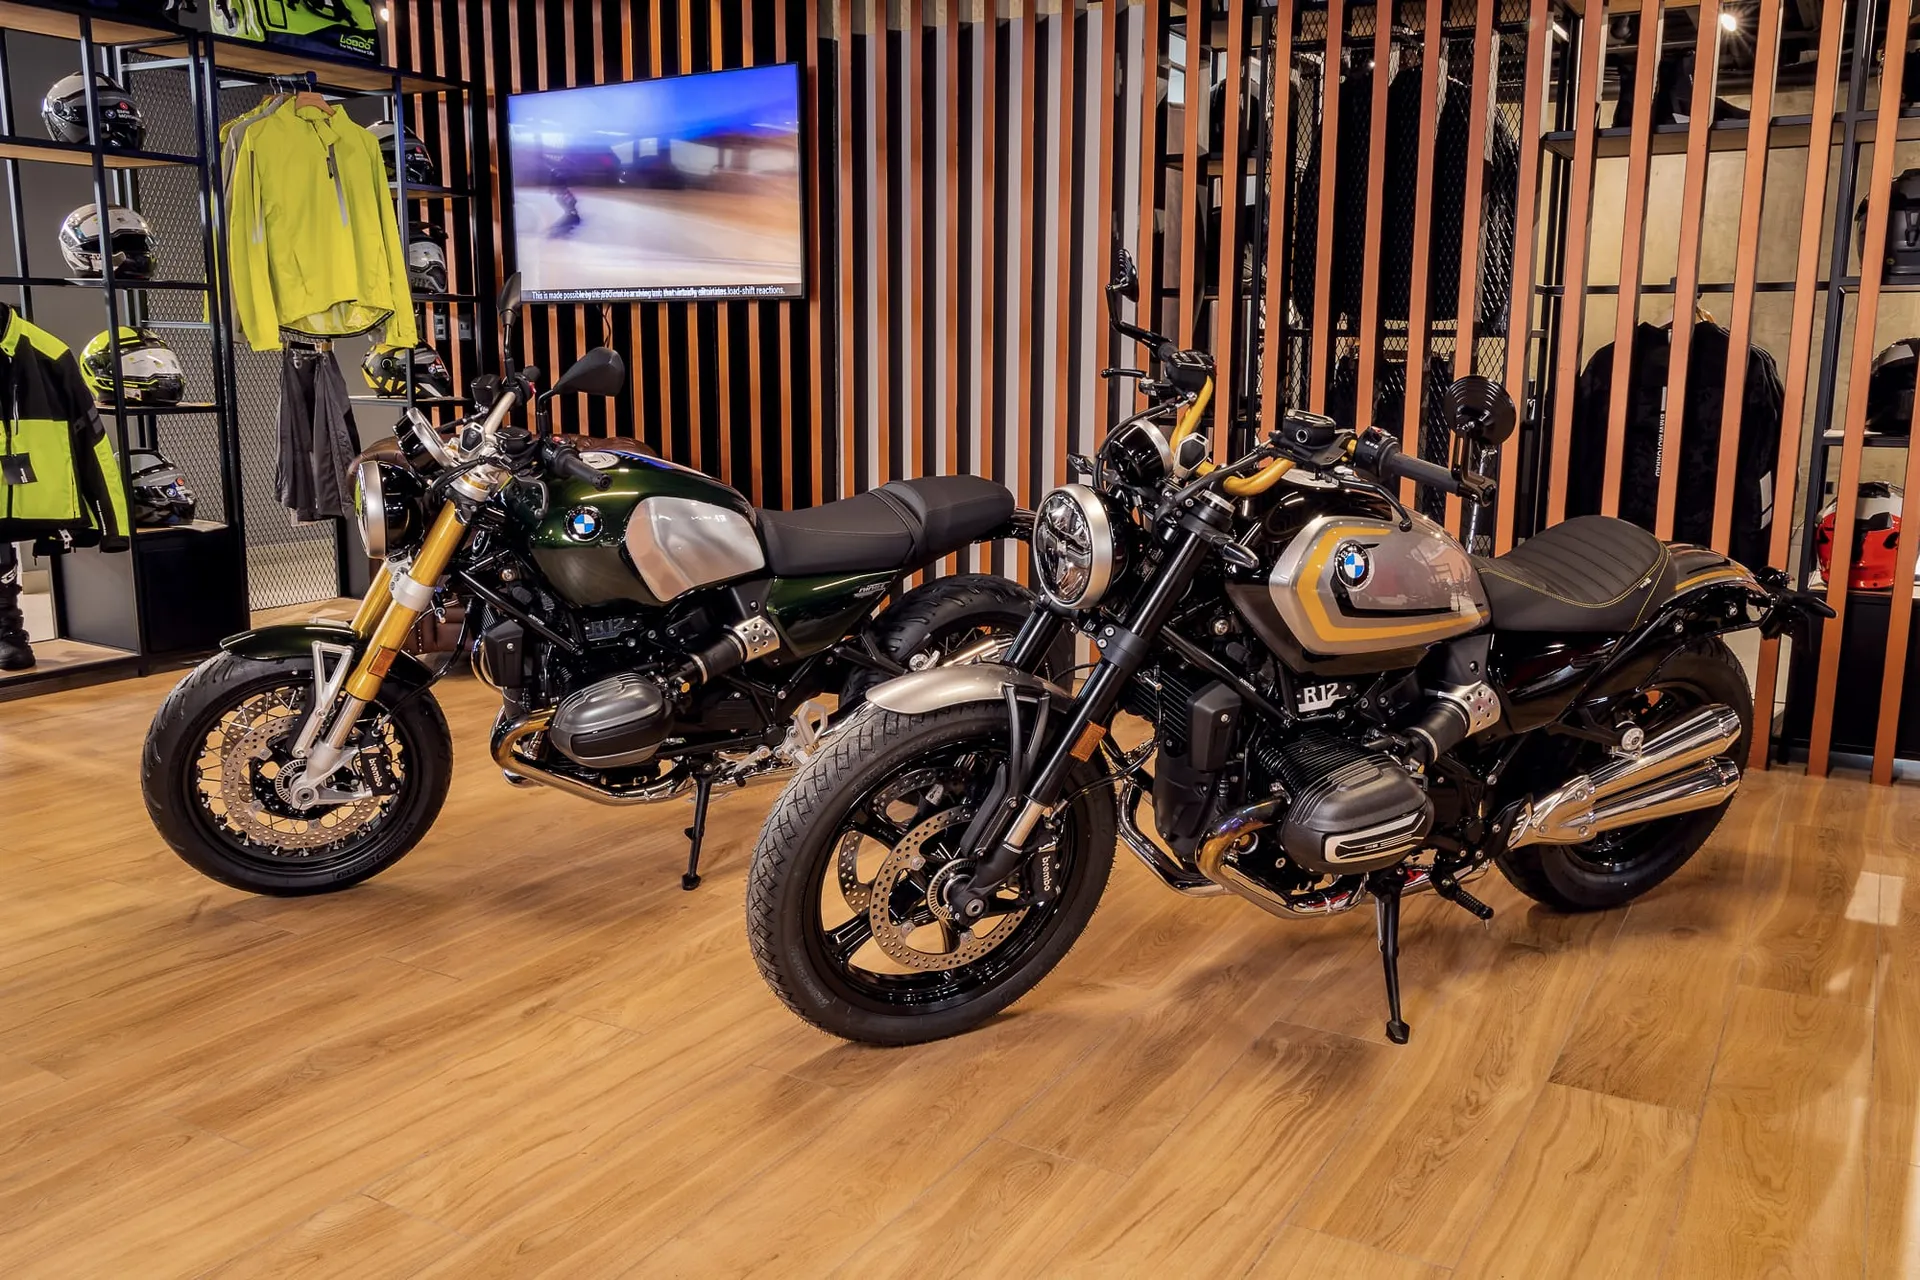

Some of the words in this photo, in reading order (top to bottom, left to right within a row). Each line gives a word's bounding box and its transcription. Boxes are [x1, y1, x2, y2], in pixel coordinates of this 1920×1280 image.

[727, 286, 755, 295] load-shift
[756, 285, 786, 295] reactions.
[368, 757, 383, 787] brembo
[1042, 855, 1052, 892] brembo
